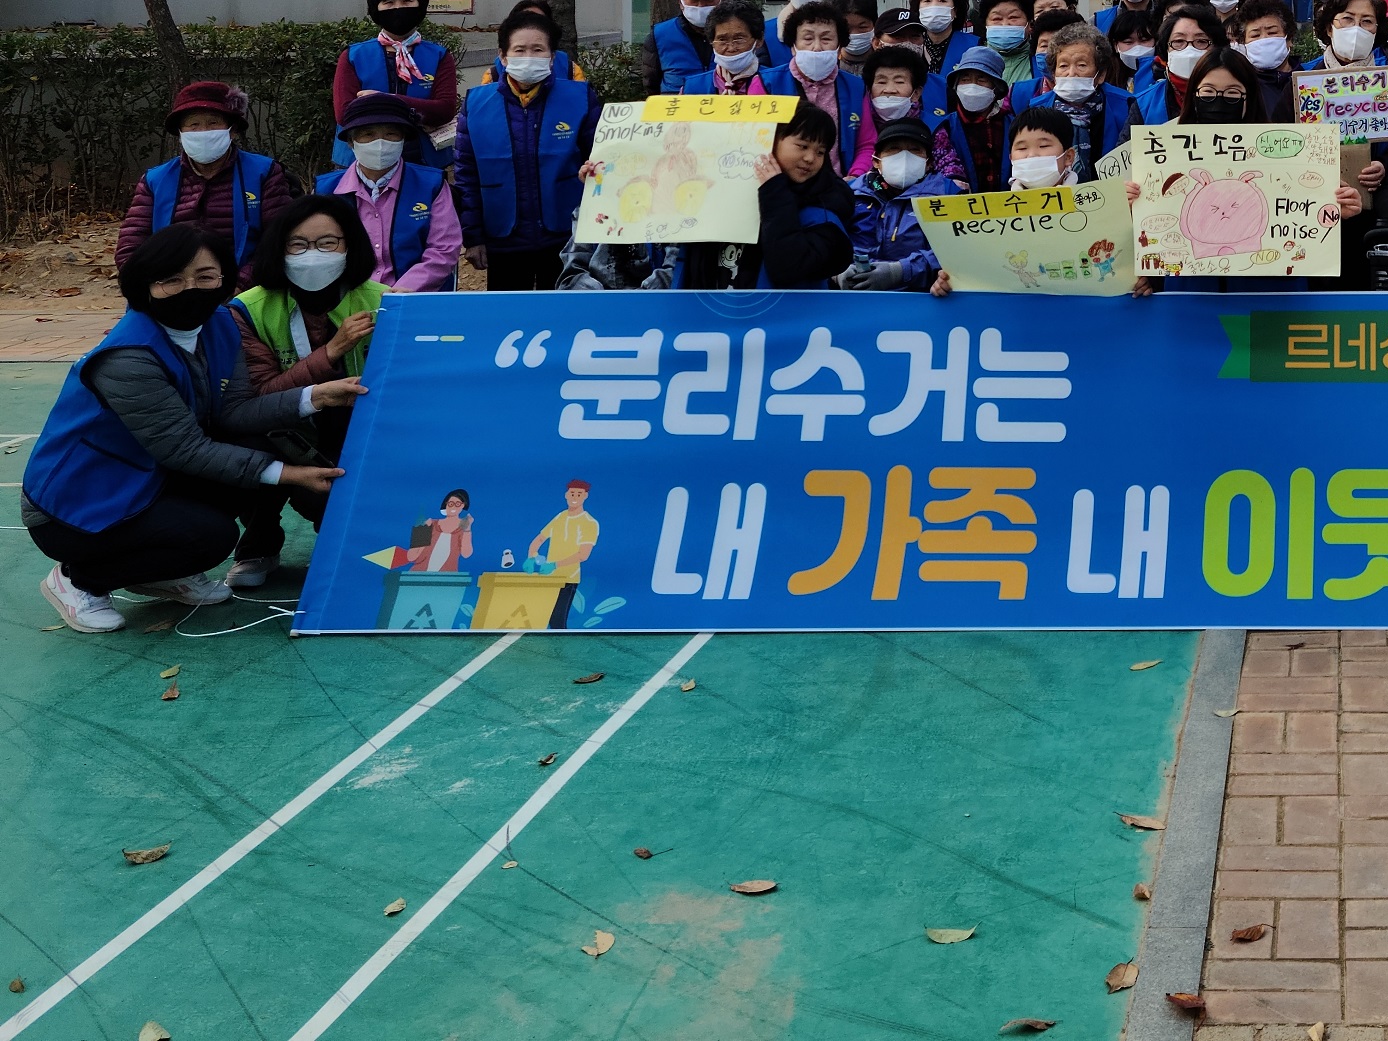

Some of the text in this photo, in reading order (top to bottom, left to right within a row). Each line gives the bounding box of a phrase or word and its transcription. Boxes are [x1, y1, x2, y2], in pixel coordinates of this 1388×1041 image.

[898, 11, 911, 20] N
[1324, 71, 1388, 95] 분리수거
[1300, 95, 1388, 118] Yes recycle
[1330, 118, 1368, 136] 리수거
[1143, 131, 1204, 165] 층간
[1212, 133, 1247, 162] 소음
[929, 190, 1102, 218] 분리수거 좋아요
[1275, 198, 1317, 217] Floor
[1270, 222, 1319, 240] noise
[650, 482, 767, 601] 내
[787, 464, 1038, 601] 가족
[1066, 484, 1170, 600] 내
